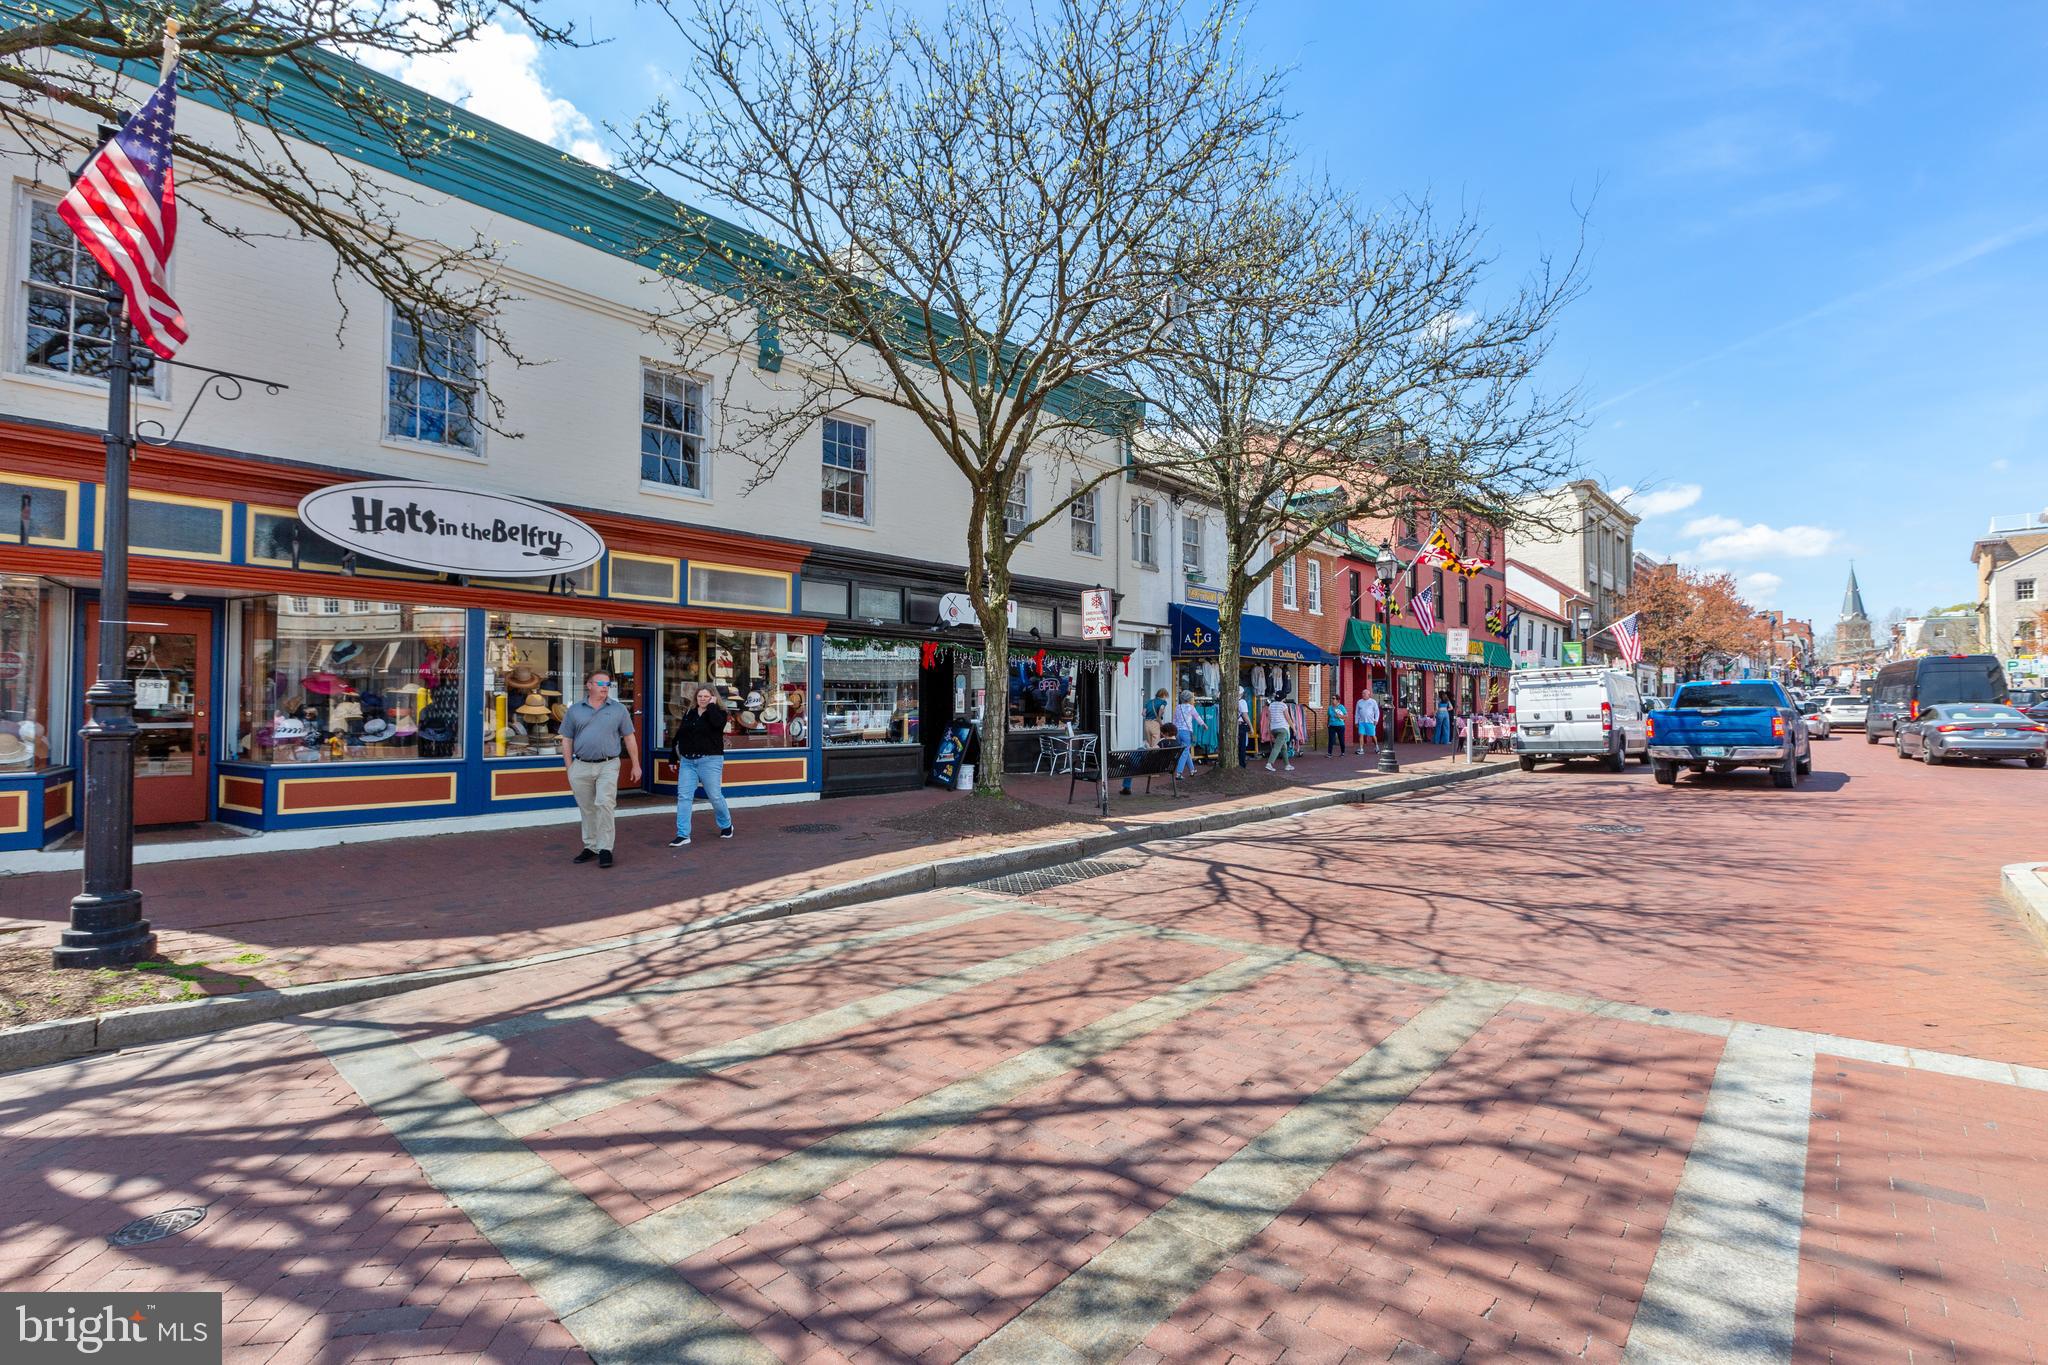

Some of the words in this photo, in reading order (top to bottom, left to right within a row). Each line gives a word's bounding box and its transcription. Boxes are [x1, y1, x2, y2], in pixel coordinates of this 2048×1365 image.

[350, 496, 437, 535] Hats
[438, 518, 457, 536] in
[461, 522, 491, 541] the
[491, 518, 563, 556] Belfry
[1184, 633, 1192, 643] A
[1203, 632, 1212, 643] G
[1251, 646, 1278, 657] NAPTOWN
[1039, 680, 1059, 691] OPEN
